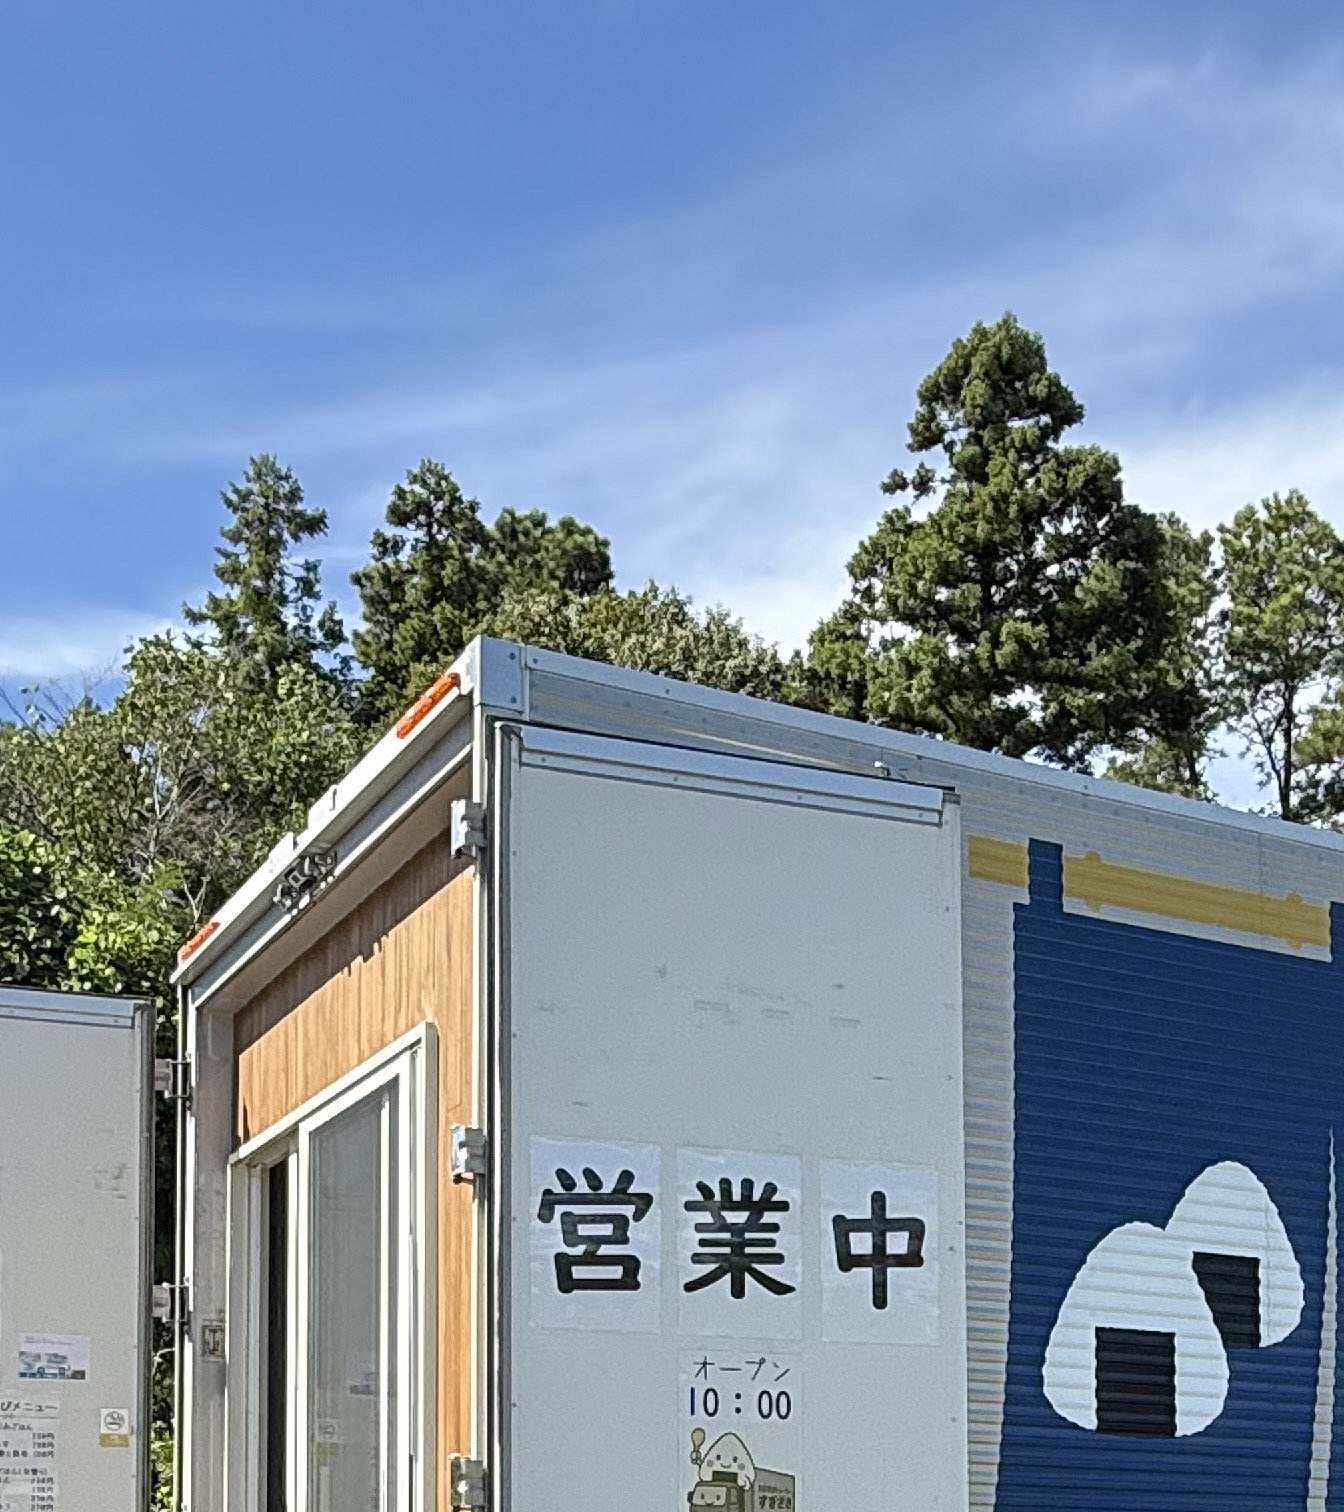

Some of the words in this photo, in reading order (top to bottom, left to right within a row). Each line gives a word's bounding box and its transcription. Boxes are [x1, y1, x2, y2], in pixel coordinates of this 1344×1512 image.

[537, 1166, 927, 1311] 営業中
[693, 1354, 791, 1382] オープン
